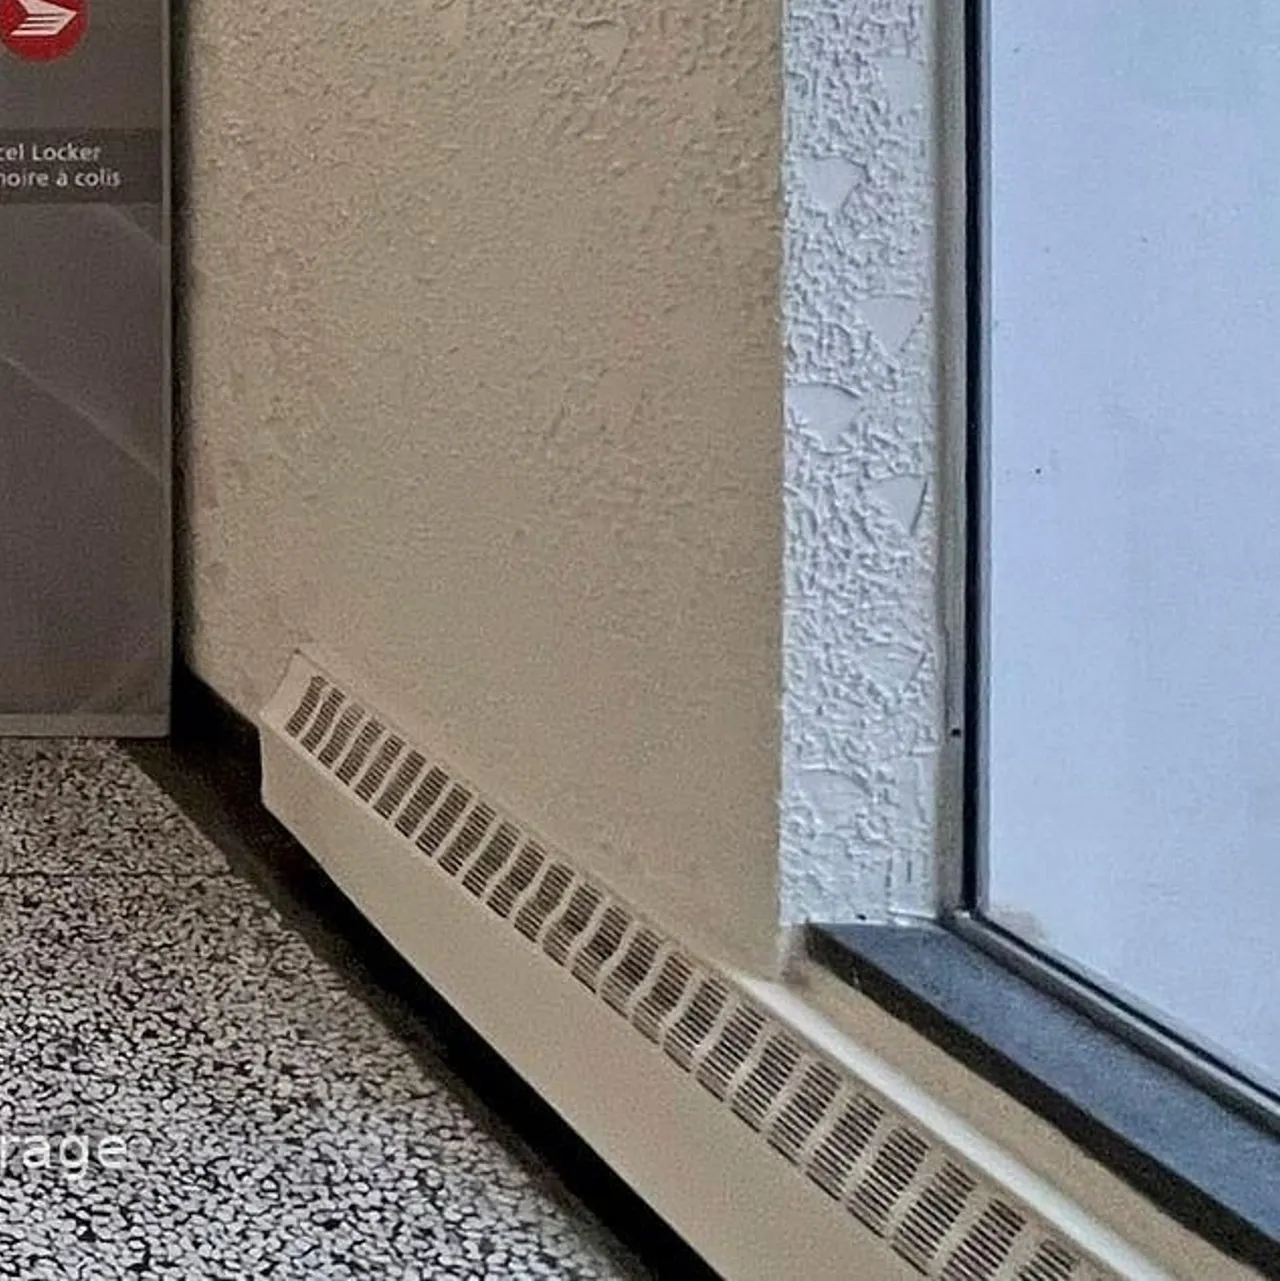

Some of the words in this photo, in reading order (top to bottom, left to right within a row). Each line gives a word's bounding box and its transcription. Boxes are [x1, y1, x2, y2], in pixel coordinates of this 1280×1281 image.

[32, 143, 101, 161] Locker
[56, 169, 69, 187] à
[74, 169, 120, 187] colis
